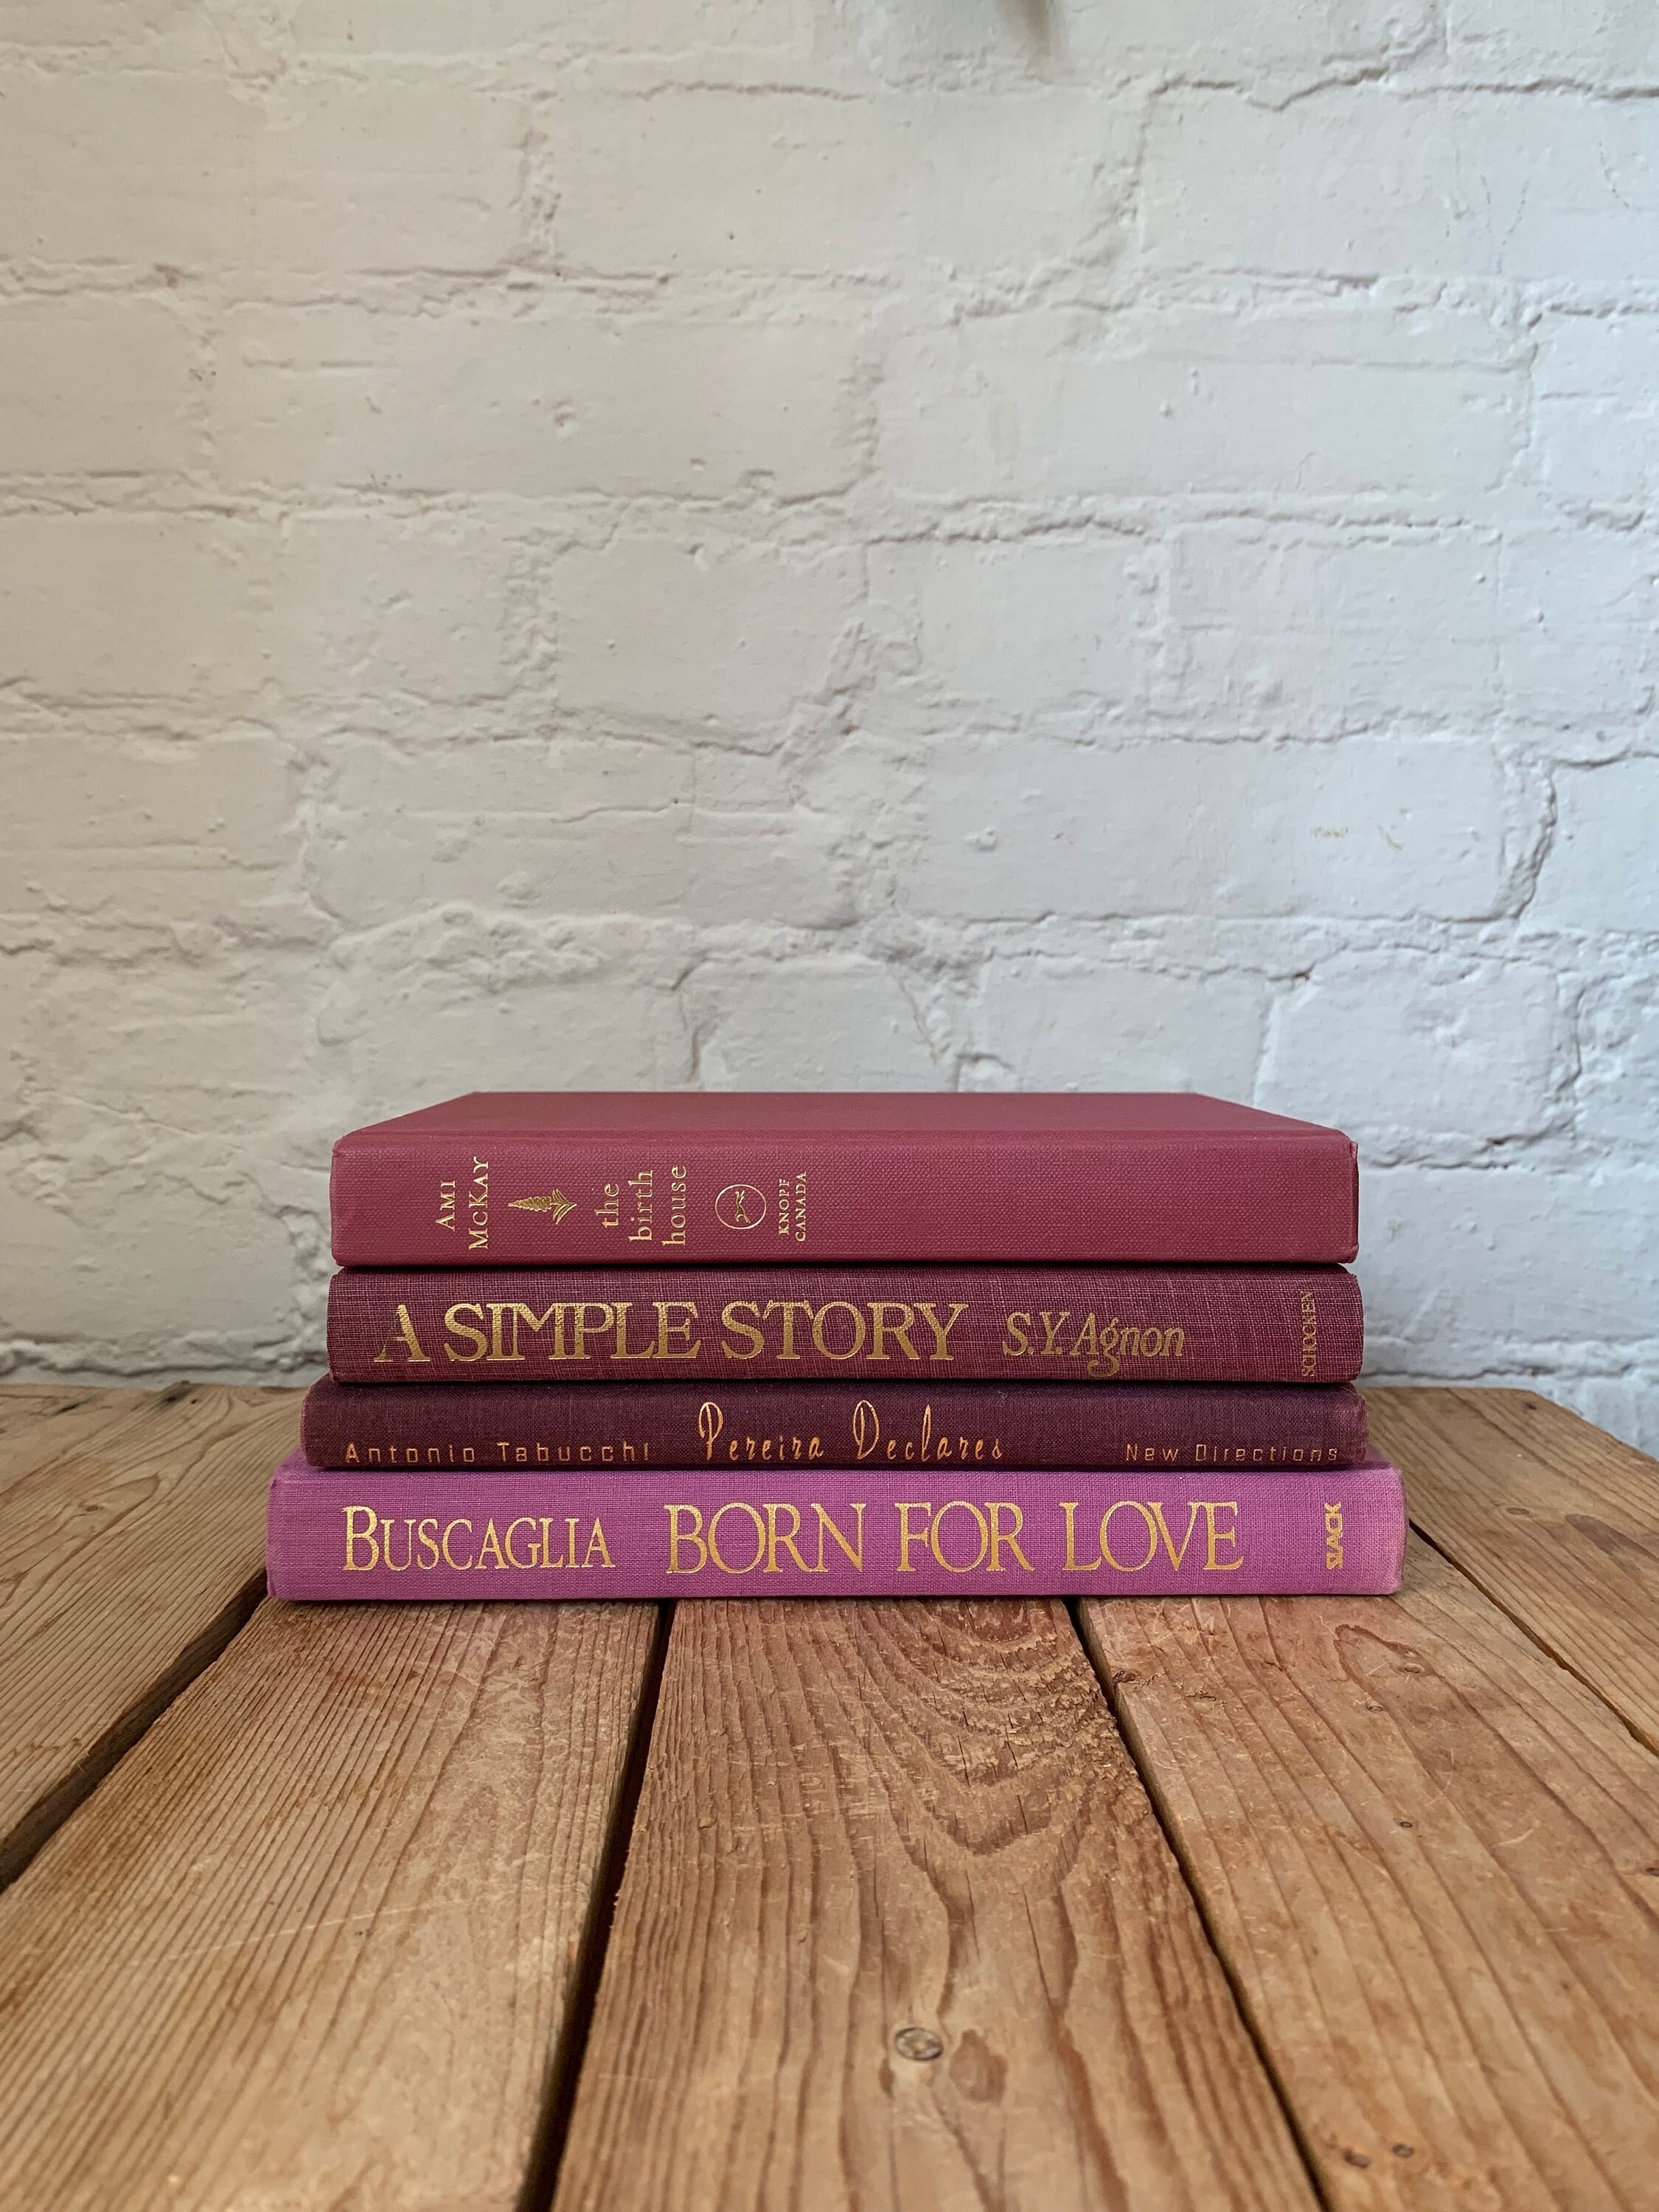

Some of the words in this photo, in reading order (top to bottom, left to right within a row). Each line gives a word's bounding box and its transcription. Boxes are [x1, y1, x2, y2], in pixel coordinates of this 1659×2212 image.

[435, 1179, 456, 1232] AMI
[468, 1156, 490, 1251] McKAY
[594, 1182, 619, 1228] the
[629, 1169, 653, 1242] birth
[663, 1164, 686, 1247] house
[778, 1178, 790, 1236] KNOPF
[795, 1171, 807, 1242] CANADA
[373, 1304, 431, 1363] A
[443, 1301, 701, 1363] SIMPLE
[720, 1301, 967, 1362] STORY
[1070, 1312, 1185, 1377] Agnon
[1301, 1290, 1317, 1377] SCHOCKEN
[345, 1442, 476, 1464] Antonio
[498, 1441, 651, 1463] Tabucchi
[698, 1401, 824, 1461] Pereira
[852, 1399, 1003, 1461] Declares
[1125, 1443, 1180, 1462] New
[1195, 1443, 1338, 1462] Directions
[664, 1501, 867, 1575] BORN
[896, 1500, 1036, 1573] FOR
[1059, 1500, 1245, 1573] LOVE
